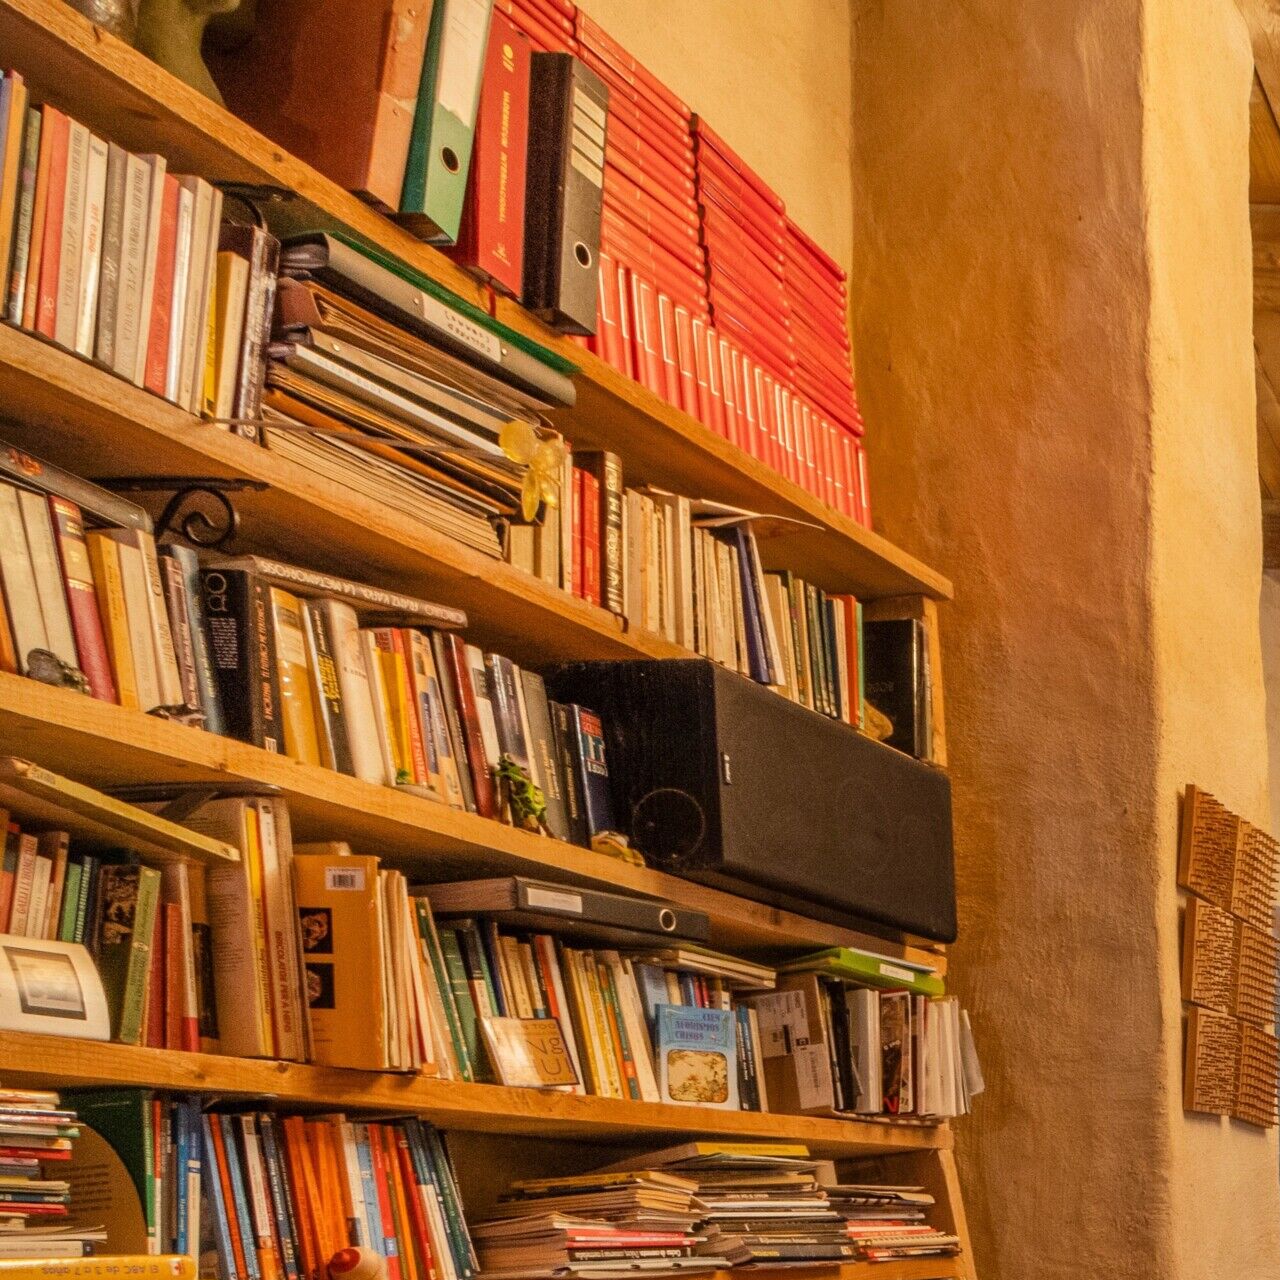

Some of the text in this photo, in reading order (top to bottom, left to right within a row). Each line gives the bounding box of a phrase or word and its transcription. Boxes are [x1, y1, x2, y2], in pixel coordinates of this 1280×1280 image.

[41, 1267, 68, 1275] años
[106, 1266, 119, 1274] de
[123, 1265, 144, 1274] ABC
